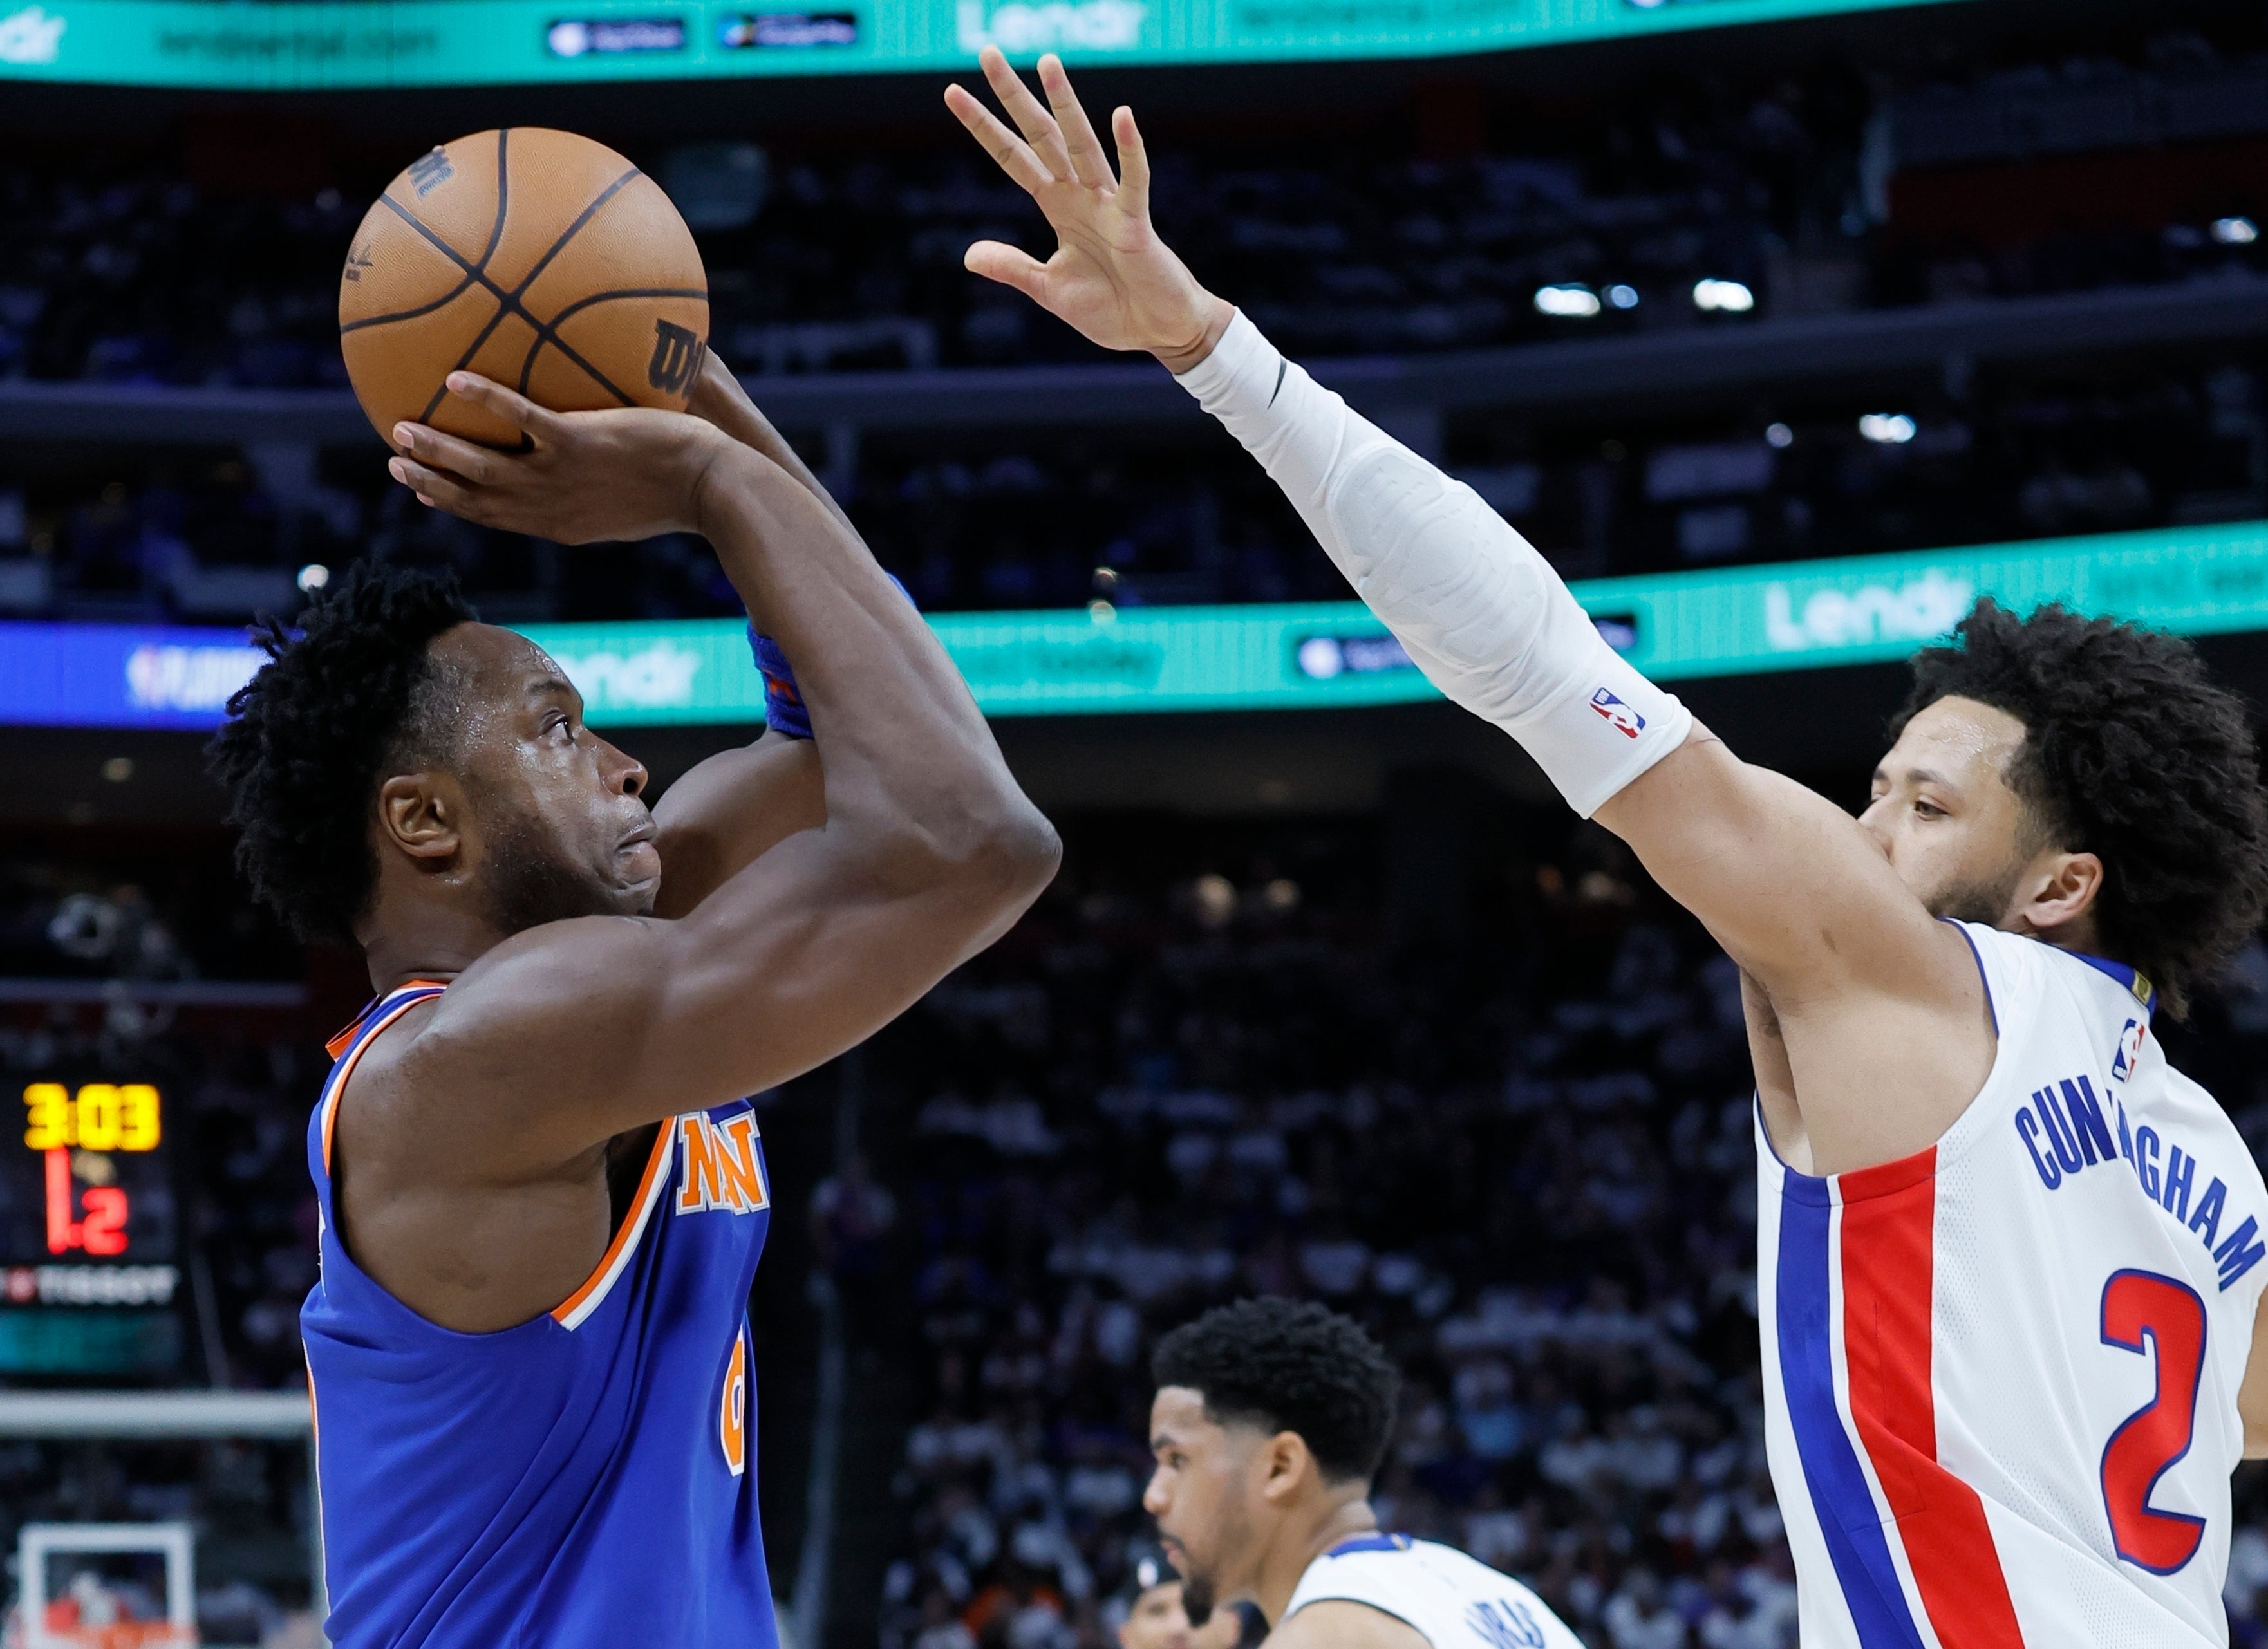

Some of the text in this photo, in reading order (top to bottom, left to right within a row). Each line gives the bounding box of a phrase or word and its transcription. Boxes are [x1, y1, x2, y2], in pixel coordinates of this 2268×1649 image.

[1765, 568, 1974, 652] Lendr
[23, 1083, 161, 1151] 3:03
[2014, 1074, 2266, 1292] CUNGHAM
[2099, 1267, 2208, 1577] 2
